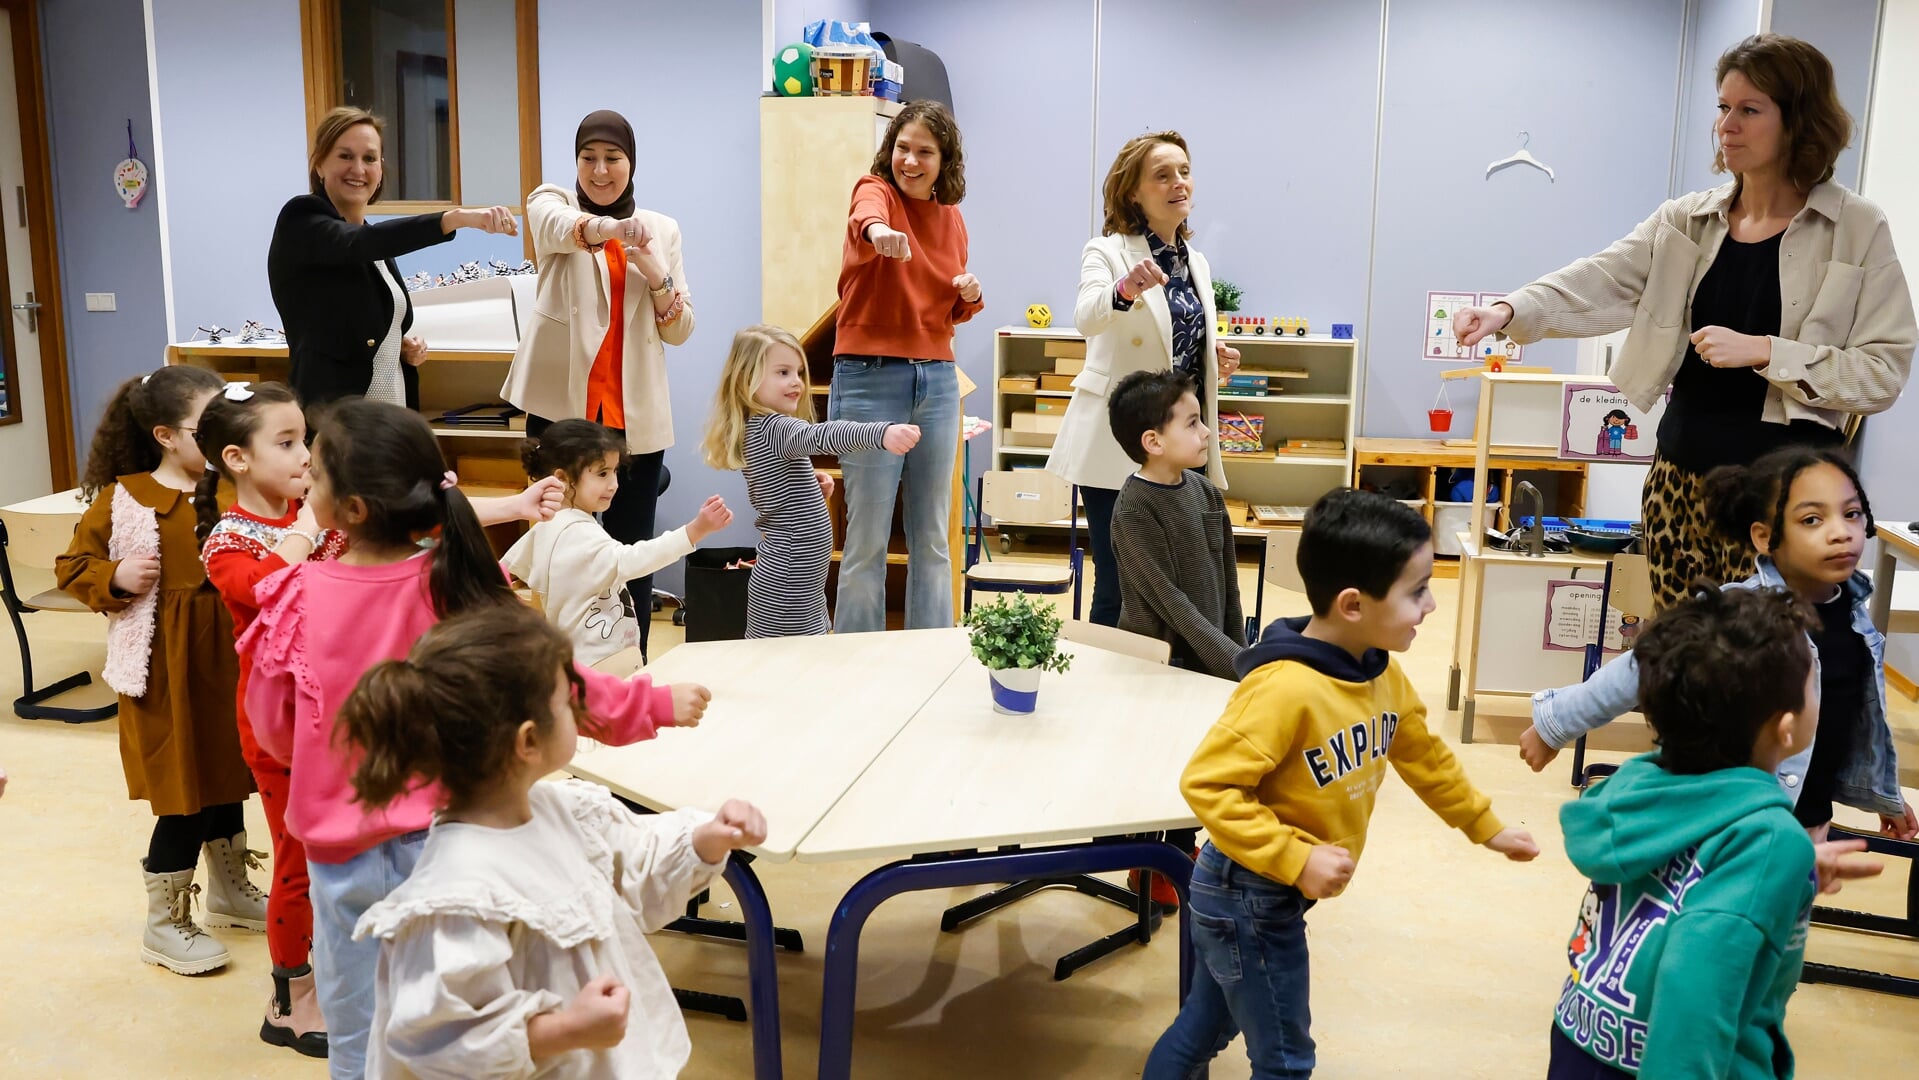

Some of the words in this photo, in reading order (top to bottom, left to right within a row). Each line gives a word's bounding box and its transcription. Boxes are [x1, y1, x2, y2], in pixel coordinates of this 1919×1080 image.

[1579, 395, 1591, 403] de
[1596, 396, 1629, 406] kleding
[1569, 592, 1602, 601] opening
